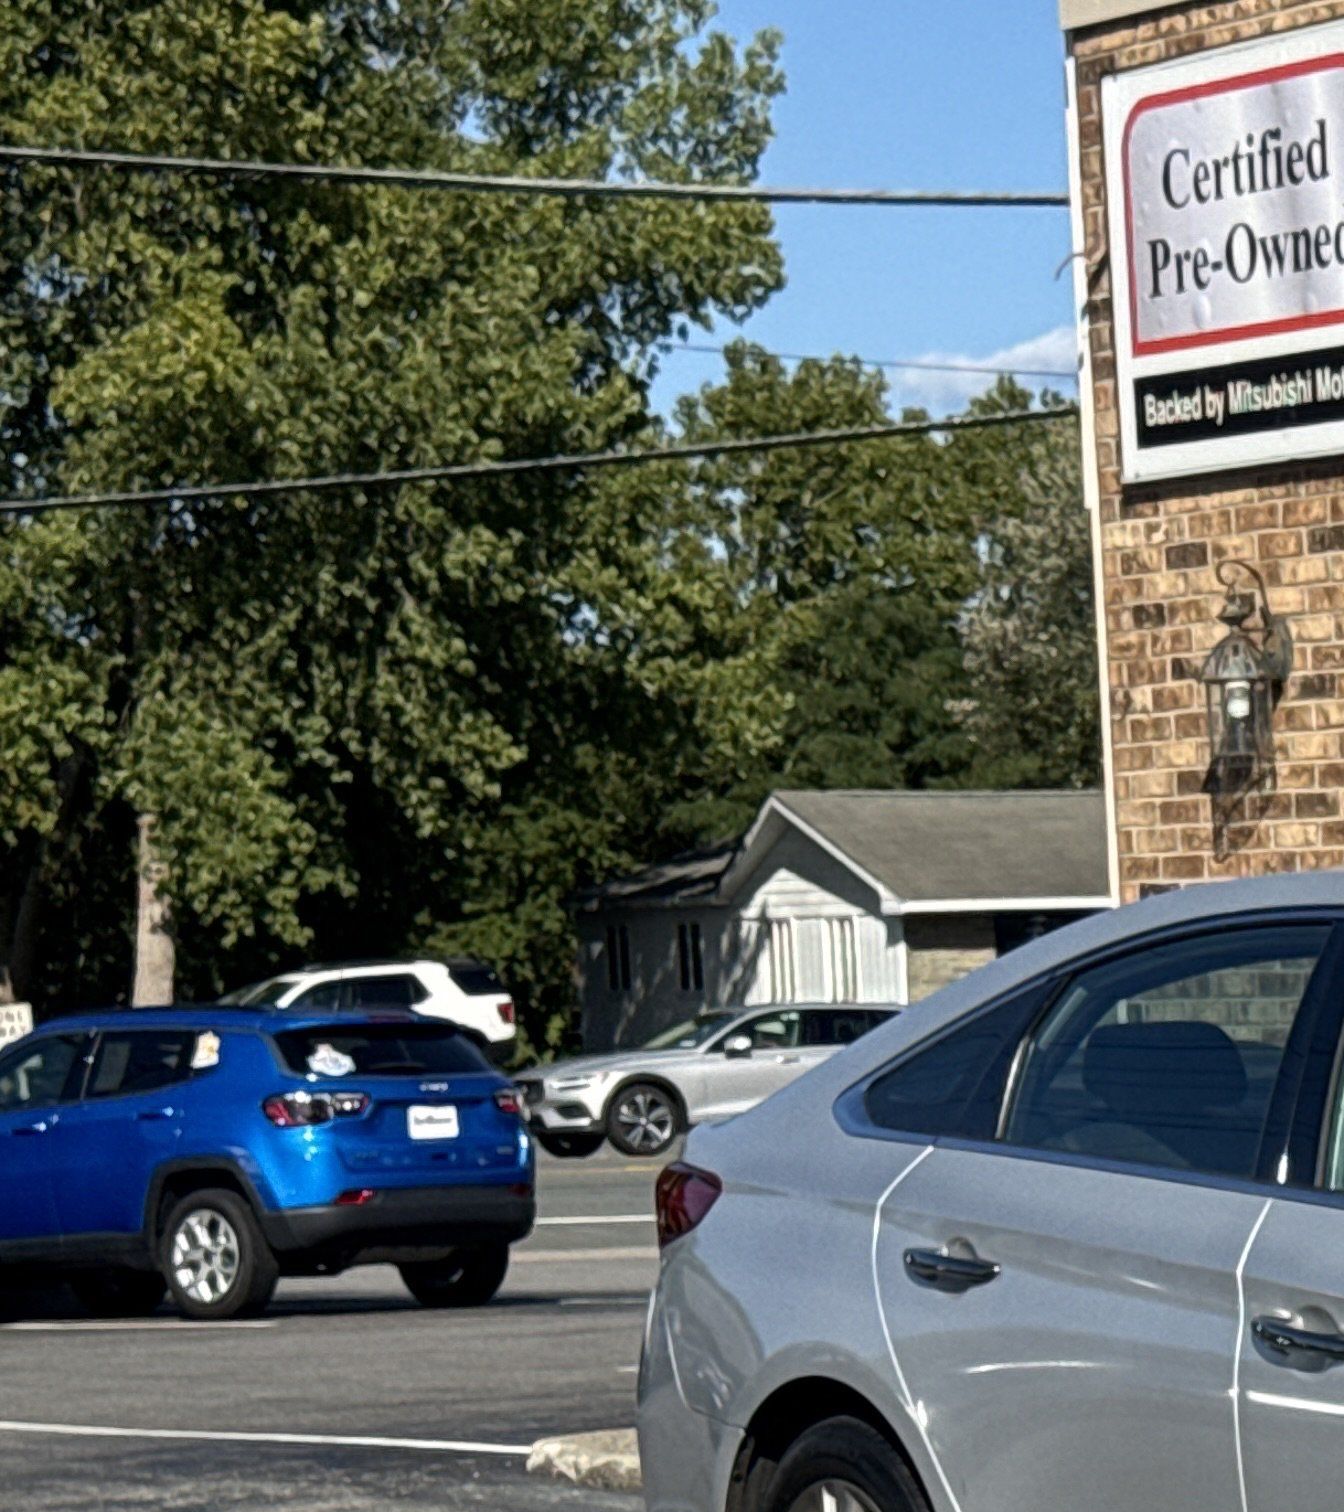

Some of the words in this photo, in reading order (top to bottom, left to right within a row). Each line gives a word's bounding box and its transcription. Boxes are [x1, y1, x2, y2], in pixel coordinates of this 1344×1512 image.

[1161, 118, 1330, 210] Certified
[1144, 387, 1201, 427] Backed
[1204, 383, 1225, 427] by
[1227, 370, 1312, 415] Mitsubishi
